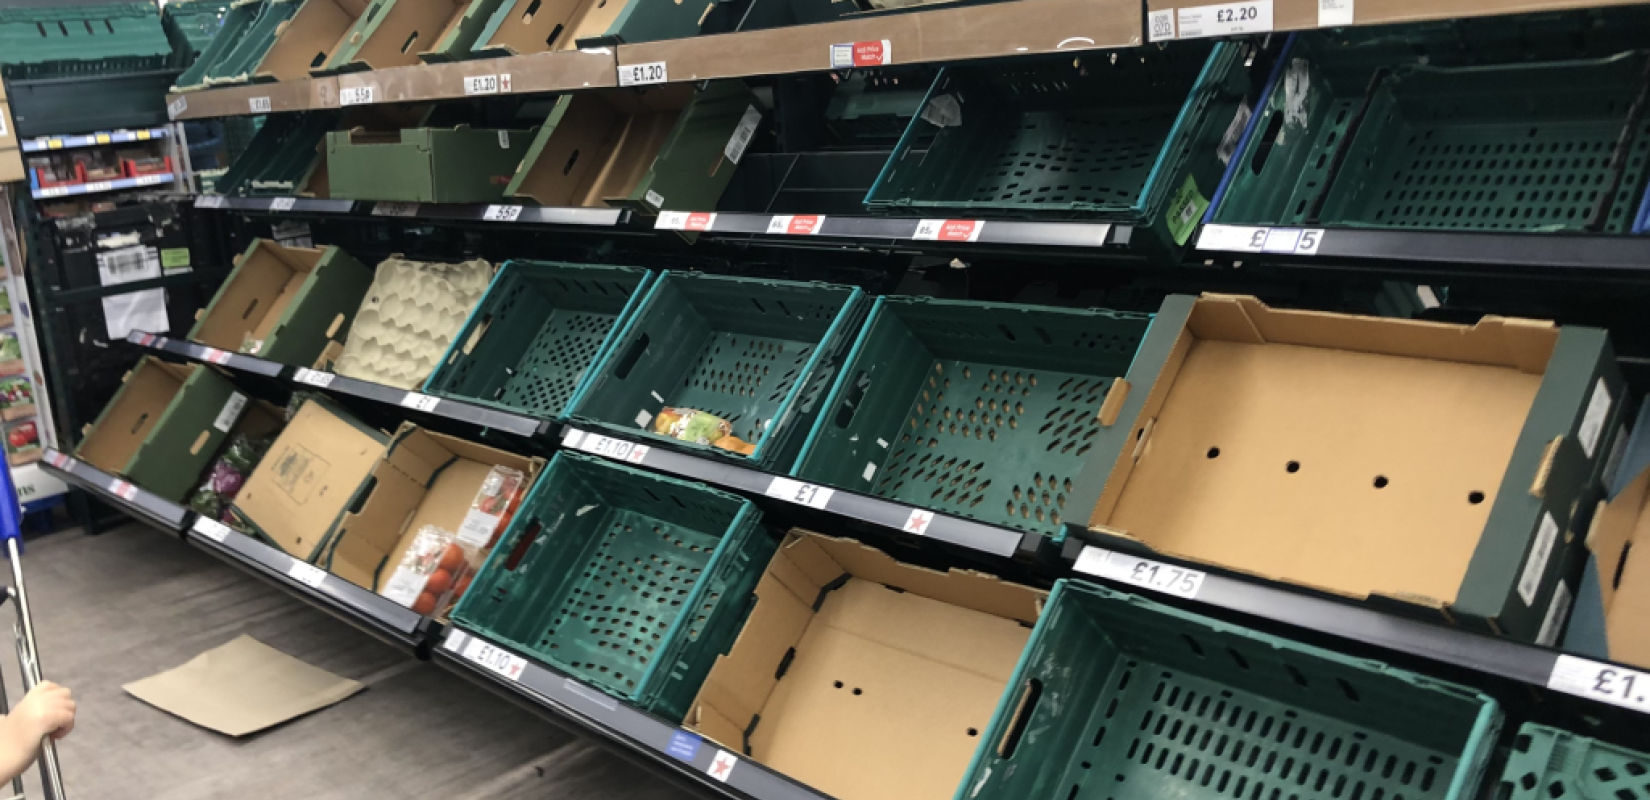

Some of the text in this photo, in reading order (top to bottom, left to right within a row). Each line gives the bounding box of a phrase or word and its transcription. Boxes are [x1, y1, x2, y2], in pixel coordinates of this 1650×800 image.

[1217, 6, 1258, 23] £2.20
[632, 64, 663, 82] £1.20
[473, 77, 496, 91] £1.20
[595, 437, 630, 457] £1.10
[794, 484, 820, 504] £1
[1130, 561, 1199, 593] £1.75
[476, 645, 511, 670] £1.10
